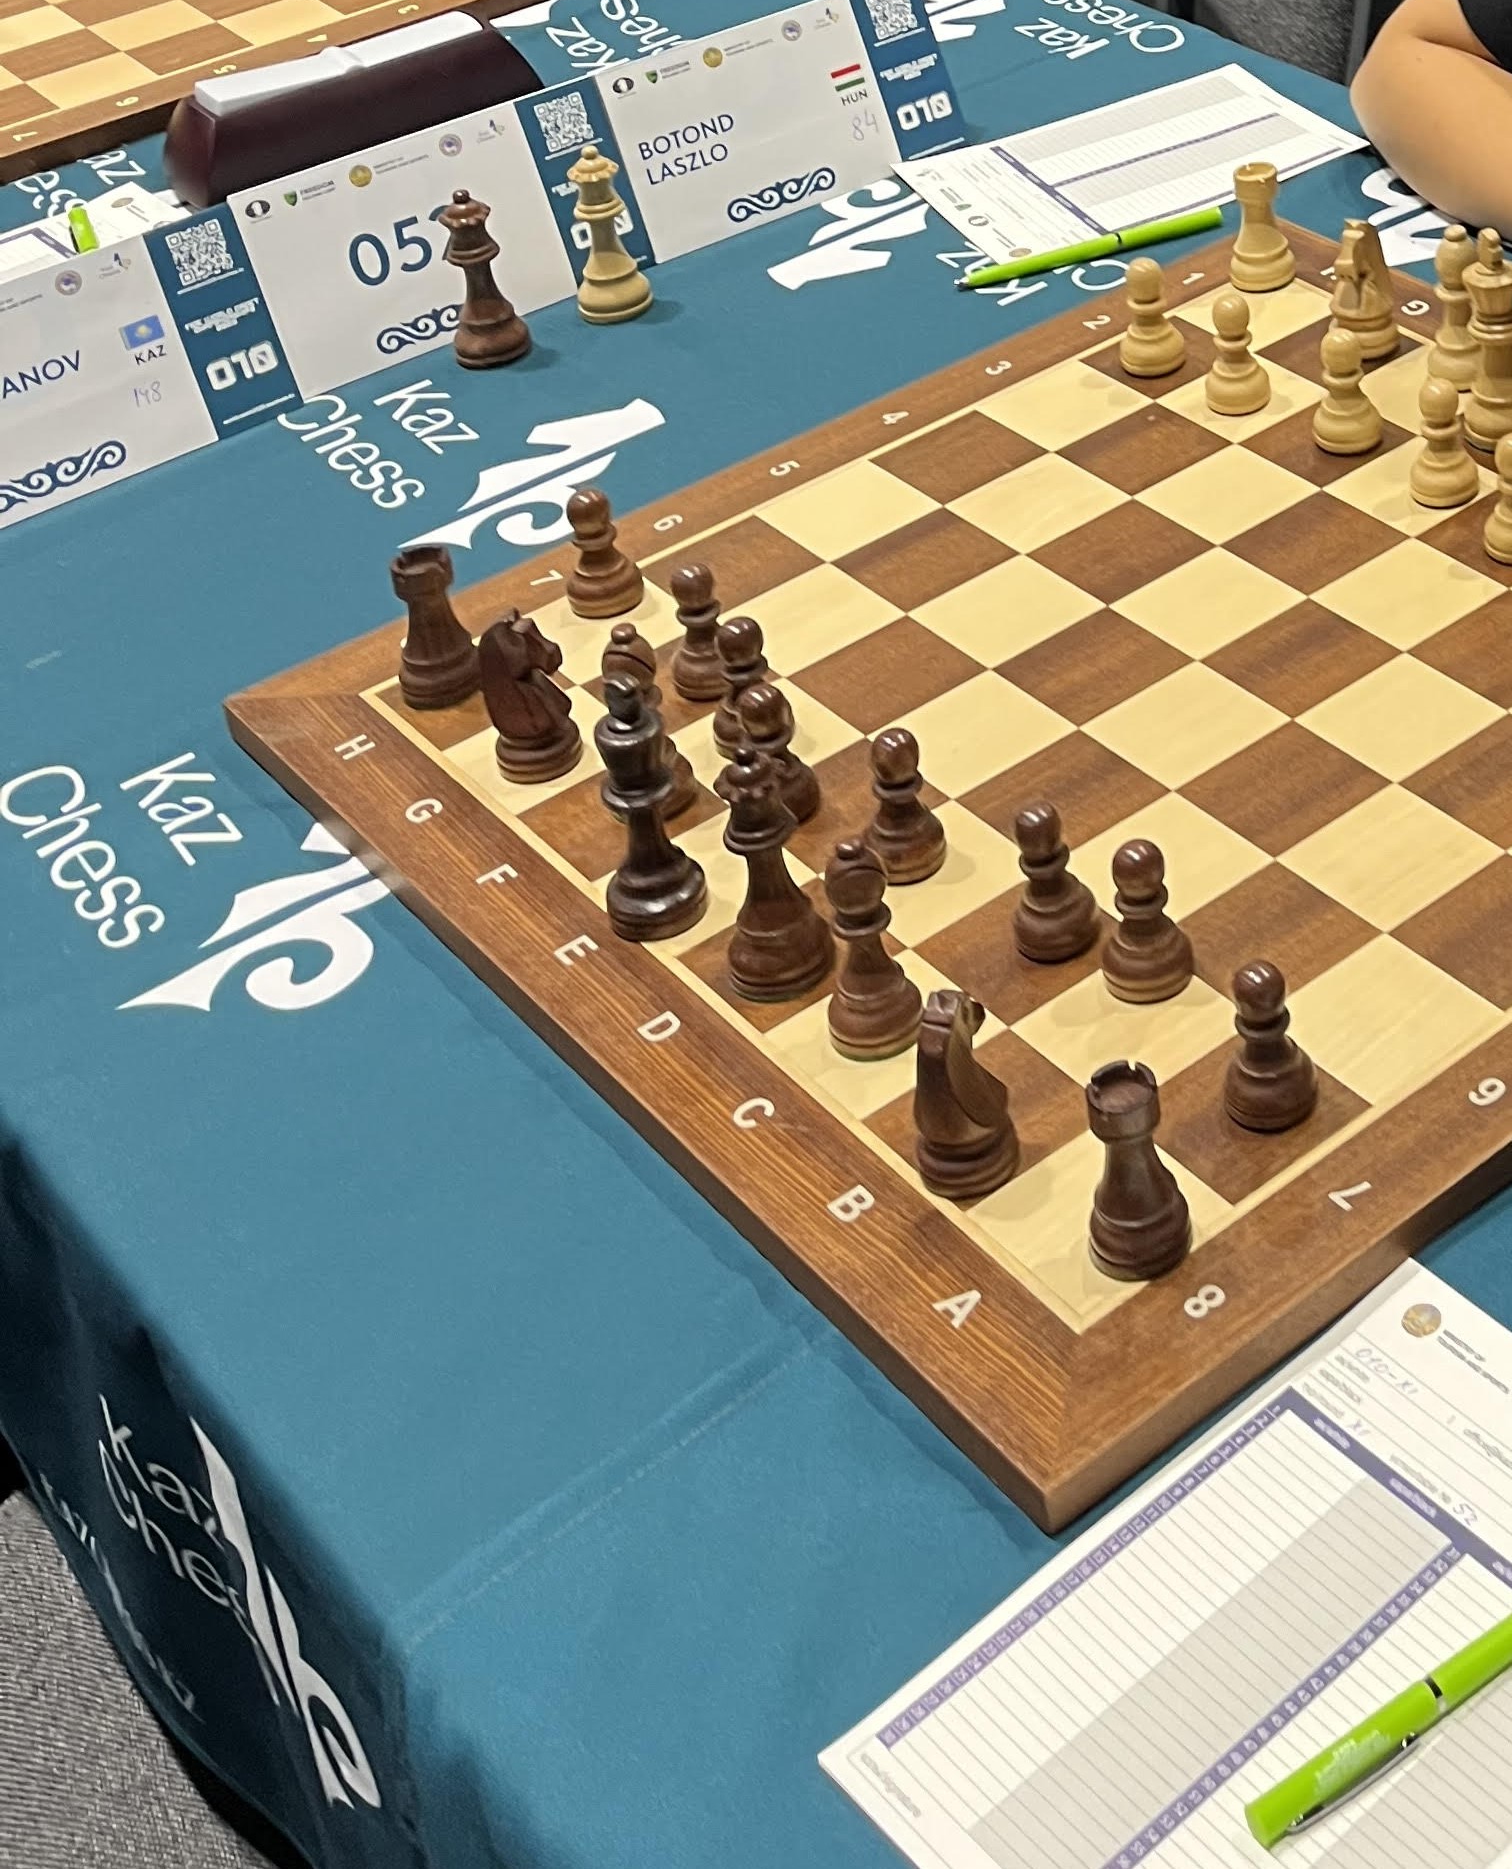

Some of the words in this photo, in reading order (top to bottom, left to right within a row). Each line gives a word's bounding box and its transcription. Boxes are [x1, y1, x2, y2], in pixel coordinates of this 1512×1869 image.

[544, 17, 629, 74] Kaz
[1013, 17, 1111, 61] Kaz
[840, 88, 869, 108] HUN
[638, 112, 735, 162] BOTOND
[645, 142, 730, 186] LASZLO
[1081, 313, 1113, 330] 2
[134, 344, 168, 366] KAZ
[984, 359, 1013, 378] 3
[373, 378, 481, 456] Kaz
[881, 409, 910, 426] 4
[276, 393, 427, 510] Chess
[768, 458, 801, 478] 5
[653, 513, 684, 533] 6
[529, 569, 564, 587] 7
[334, 733, 377, 761] H
[119, 751, 244, 867] Kaz
[404, 797, 444, 824] G
[0, 764, 166, 949] Chess
[475, 863, 519, 885] F
[553, 933, 600, 967] E
[637, 1009, 682, 1043] D
[1467, 1076, 1507, 1108] 6
[732, 1096, 776, 1130] C
[825, 1183, 876, 1224] B
[1327, 1180, 1373, 1213] 7
[932, 1288, 984, 1329] A
[1183, 1283, 1227, 1320] 8
